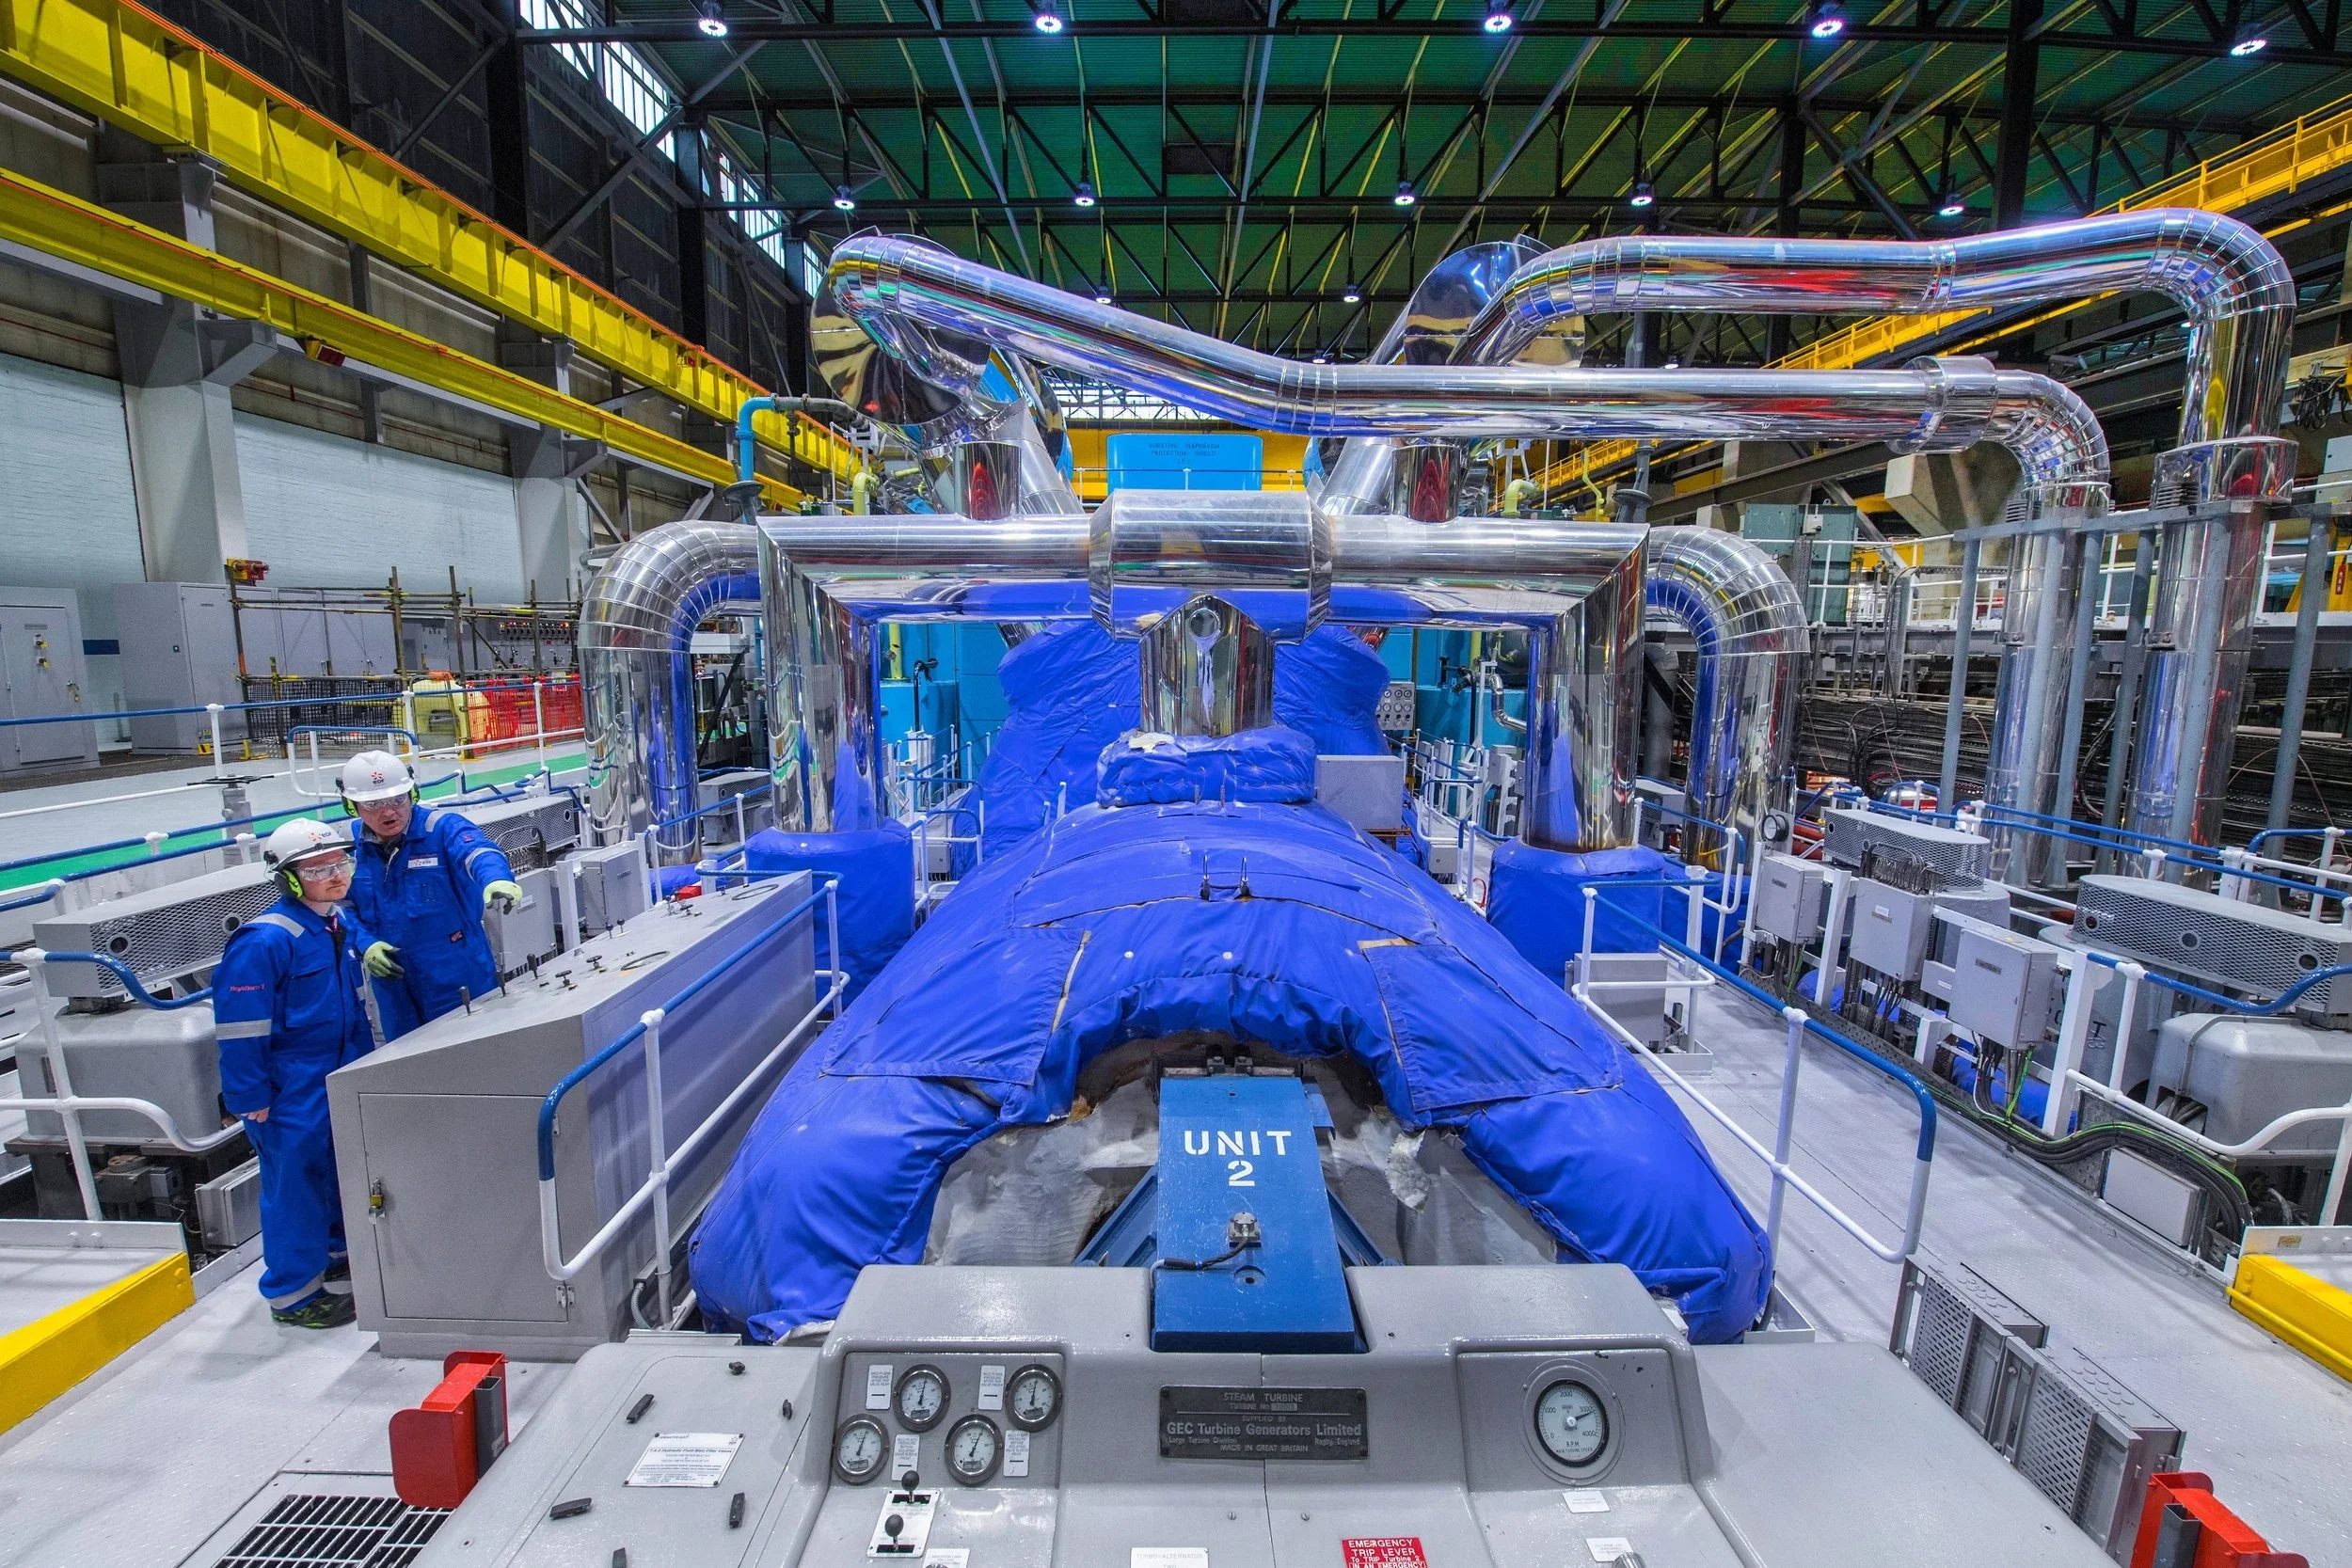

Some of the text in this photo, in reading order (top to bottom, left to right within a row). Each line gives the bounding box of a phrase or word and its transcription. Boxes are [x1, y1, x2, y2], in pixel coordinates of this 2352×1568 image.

[1184, 1131, 1291, 1155] UNIT
[1228, 1161, 1255, 1186] 2
[1224, 1393, 1303, 1402] STEAM TURBINE
[1167, 1422, 1361, 1435] GEC Turbine Generators Limited
[1168, 1436, 1185, 1445] Large
[1348, 1539, 1412, 1547] EMERGENCY
